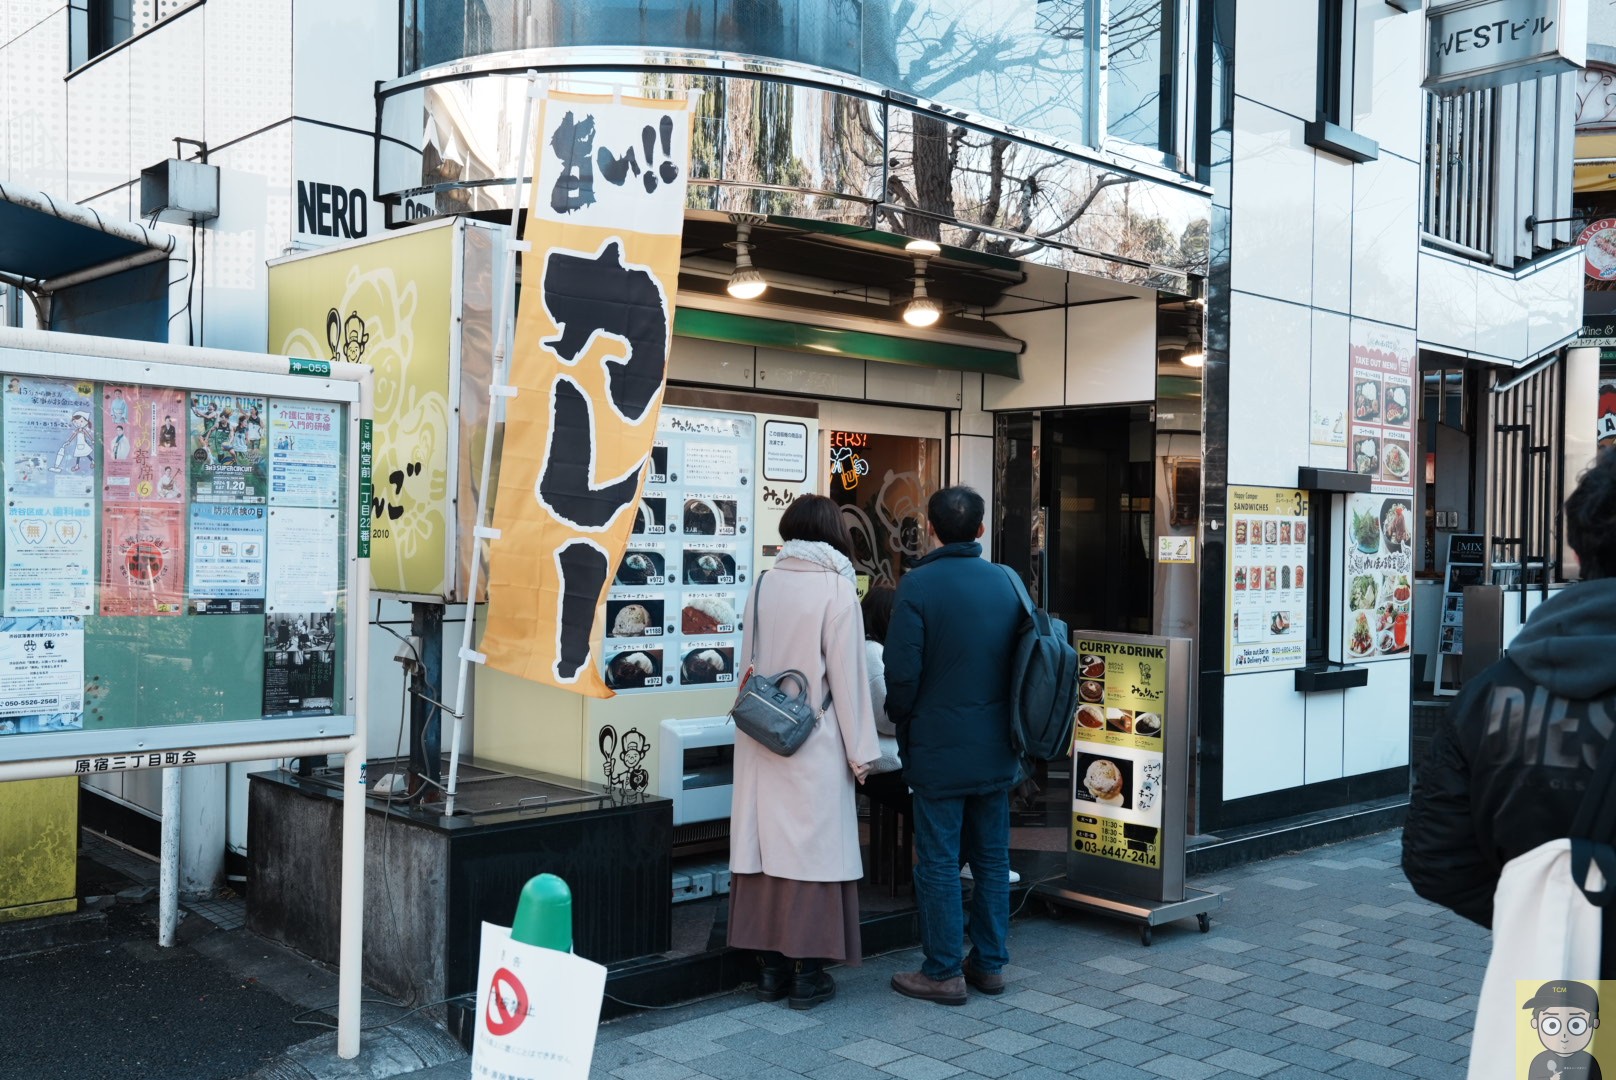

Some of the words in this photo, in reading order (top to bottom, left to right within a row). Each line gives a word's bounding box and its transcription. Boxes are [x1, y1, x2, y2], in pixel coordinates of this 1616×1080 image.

[297, 179, 368, 240] NERO
[1580, 221, 1609, 242] TACO
[195, 394, 232, 407] TOKYO
[279, 410, 331, 423] 介護に関する
[288, 420, 331, 432] 入門的研修
[540, 240, 669, 679] カレー
[226, 481, 245, 491] 1.20
[1234, 502, 1269, 511] SANDWICHES
[1294, 491, 1308, 517] 3F
[26, 525, 40, 538] 無
[62, 525, 75, 537] 料
[372, 528, 390, 539] 2010
[1160, 537, 1173, 550] 3F
[1079, 641, 1164, 659] CURRY&DRINK
[1131, 685, 1164, 700] みのりんご
[4, 698, 58, 707] 050-5526-2568
[75, 750, 197, 774] 原宿三丁目町会
[1084, 840, 1156, 866] 03-6447-2414
